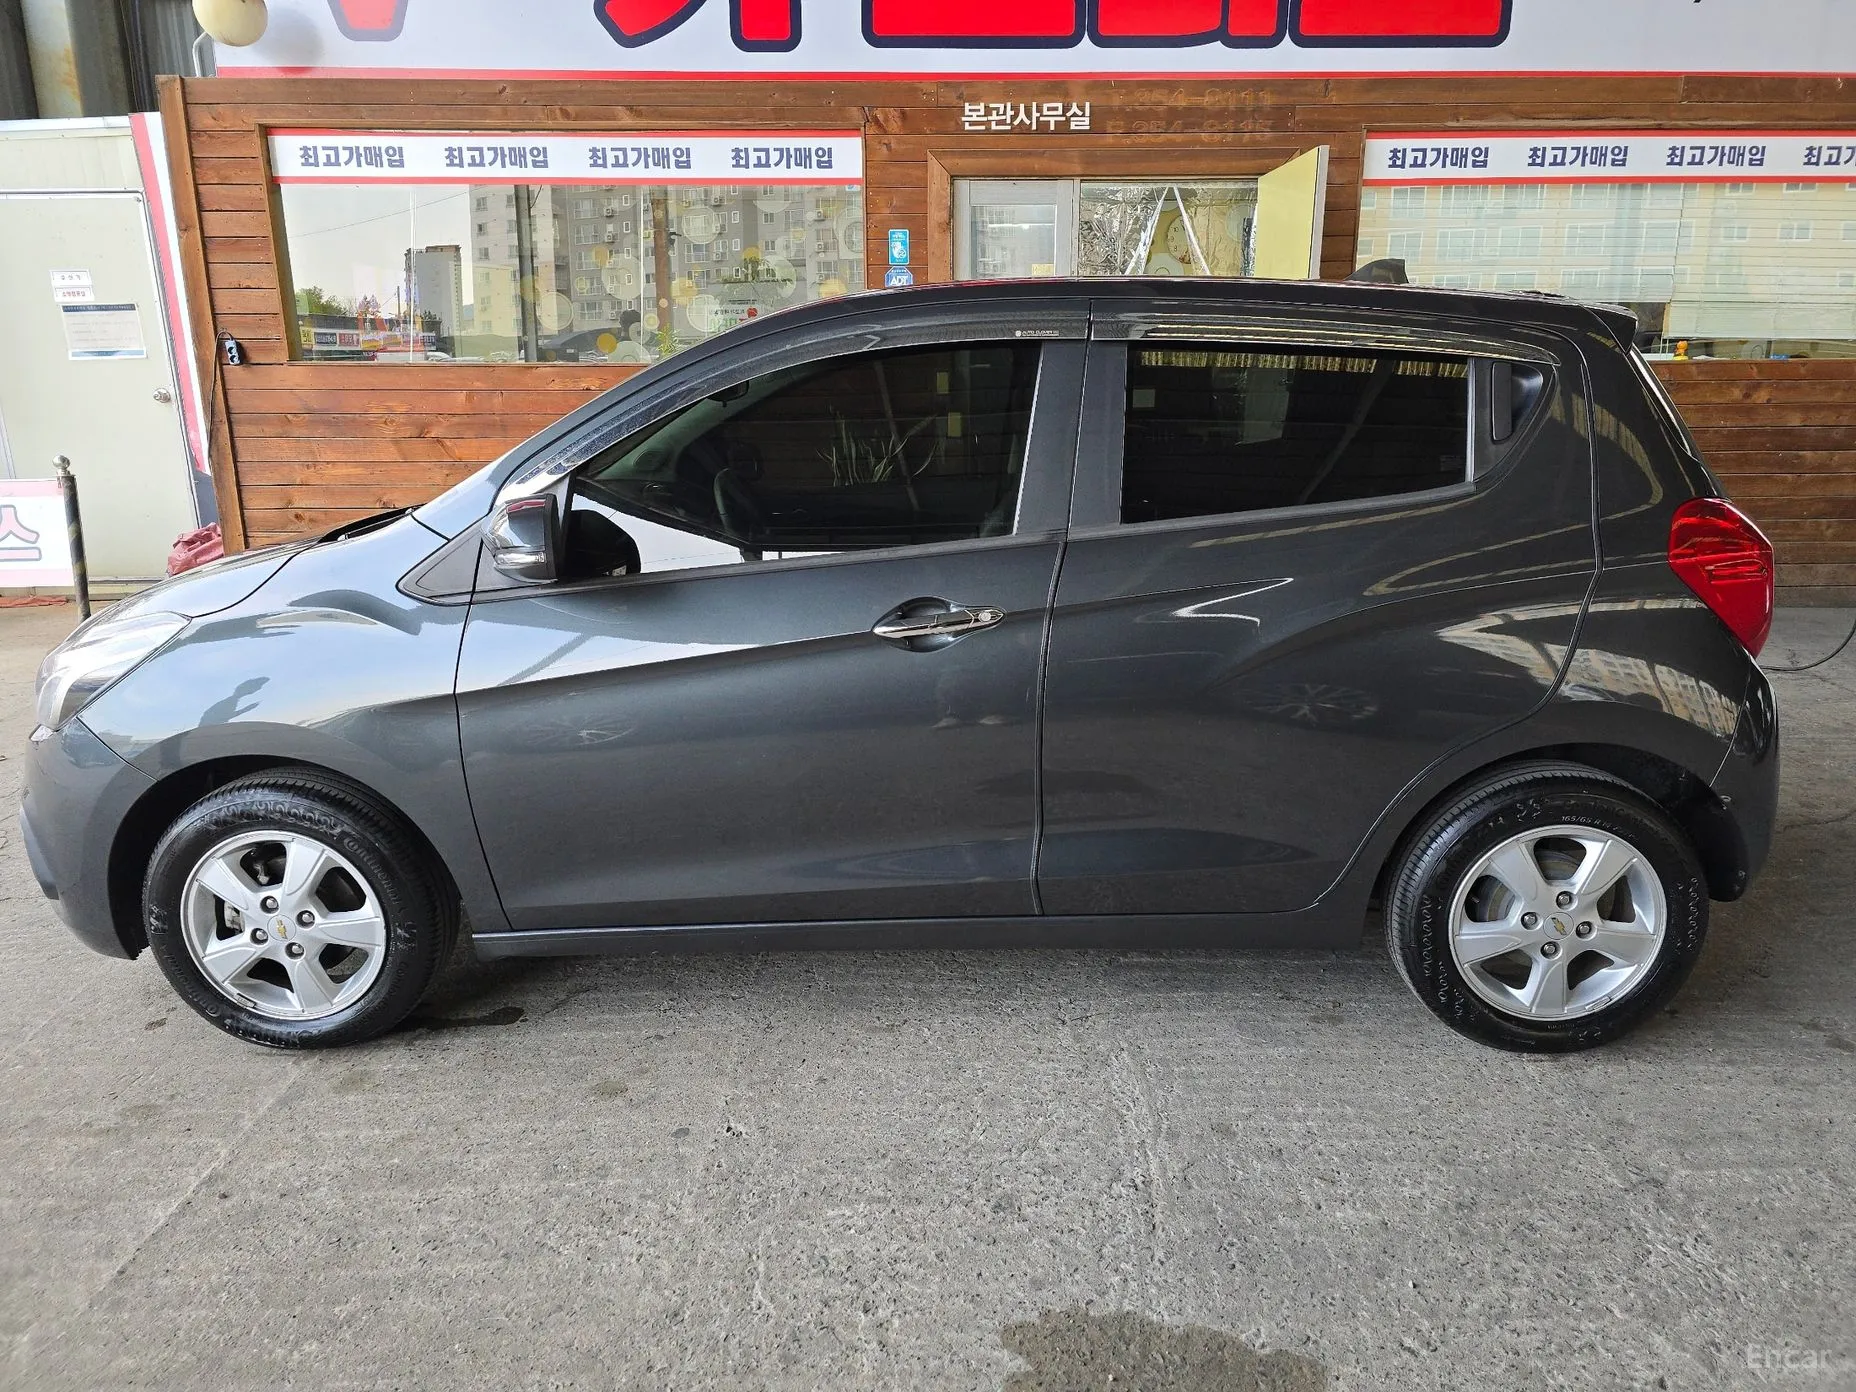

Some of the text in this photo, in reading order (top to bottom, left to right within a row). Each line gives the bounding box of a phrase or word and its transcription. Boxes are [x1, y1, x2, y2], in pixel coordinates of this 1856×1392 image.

[962, 102, 1091, 130] 본관사무실
[299, 145, 834, 170] 최고가매입 최고가매입 최고가매입 최고가매입
[1387, 146, 1490, 170] 최고가매입
[1527, 145, 1629, 168] 최고가매입
[1665, 145, 1767, 167] 최고가매입
[890, 275, 909, 286] ADT
